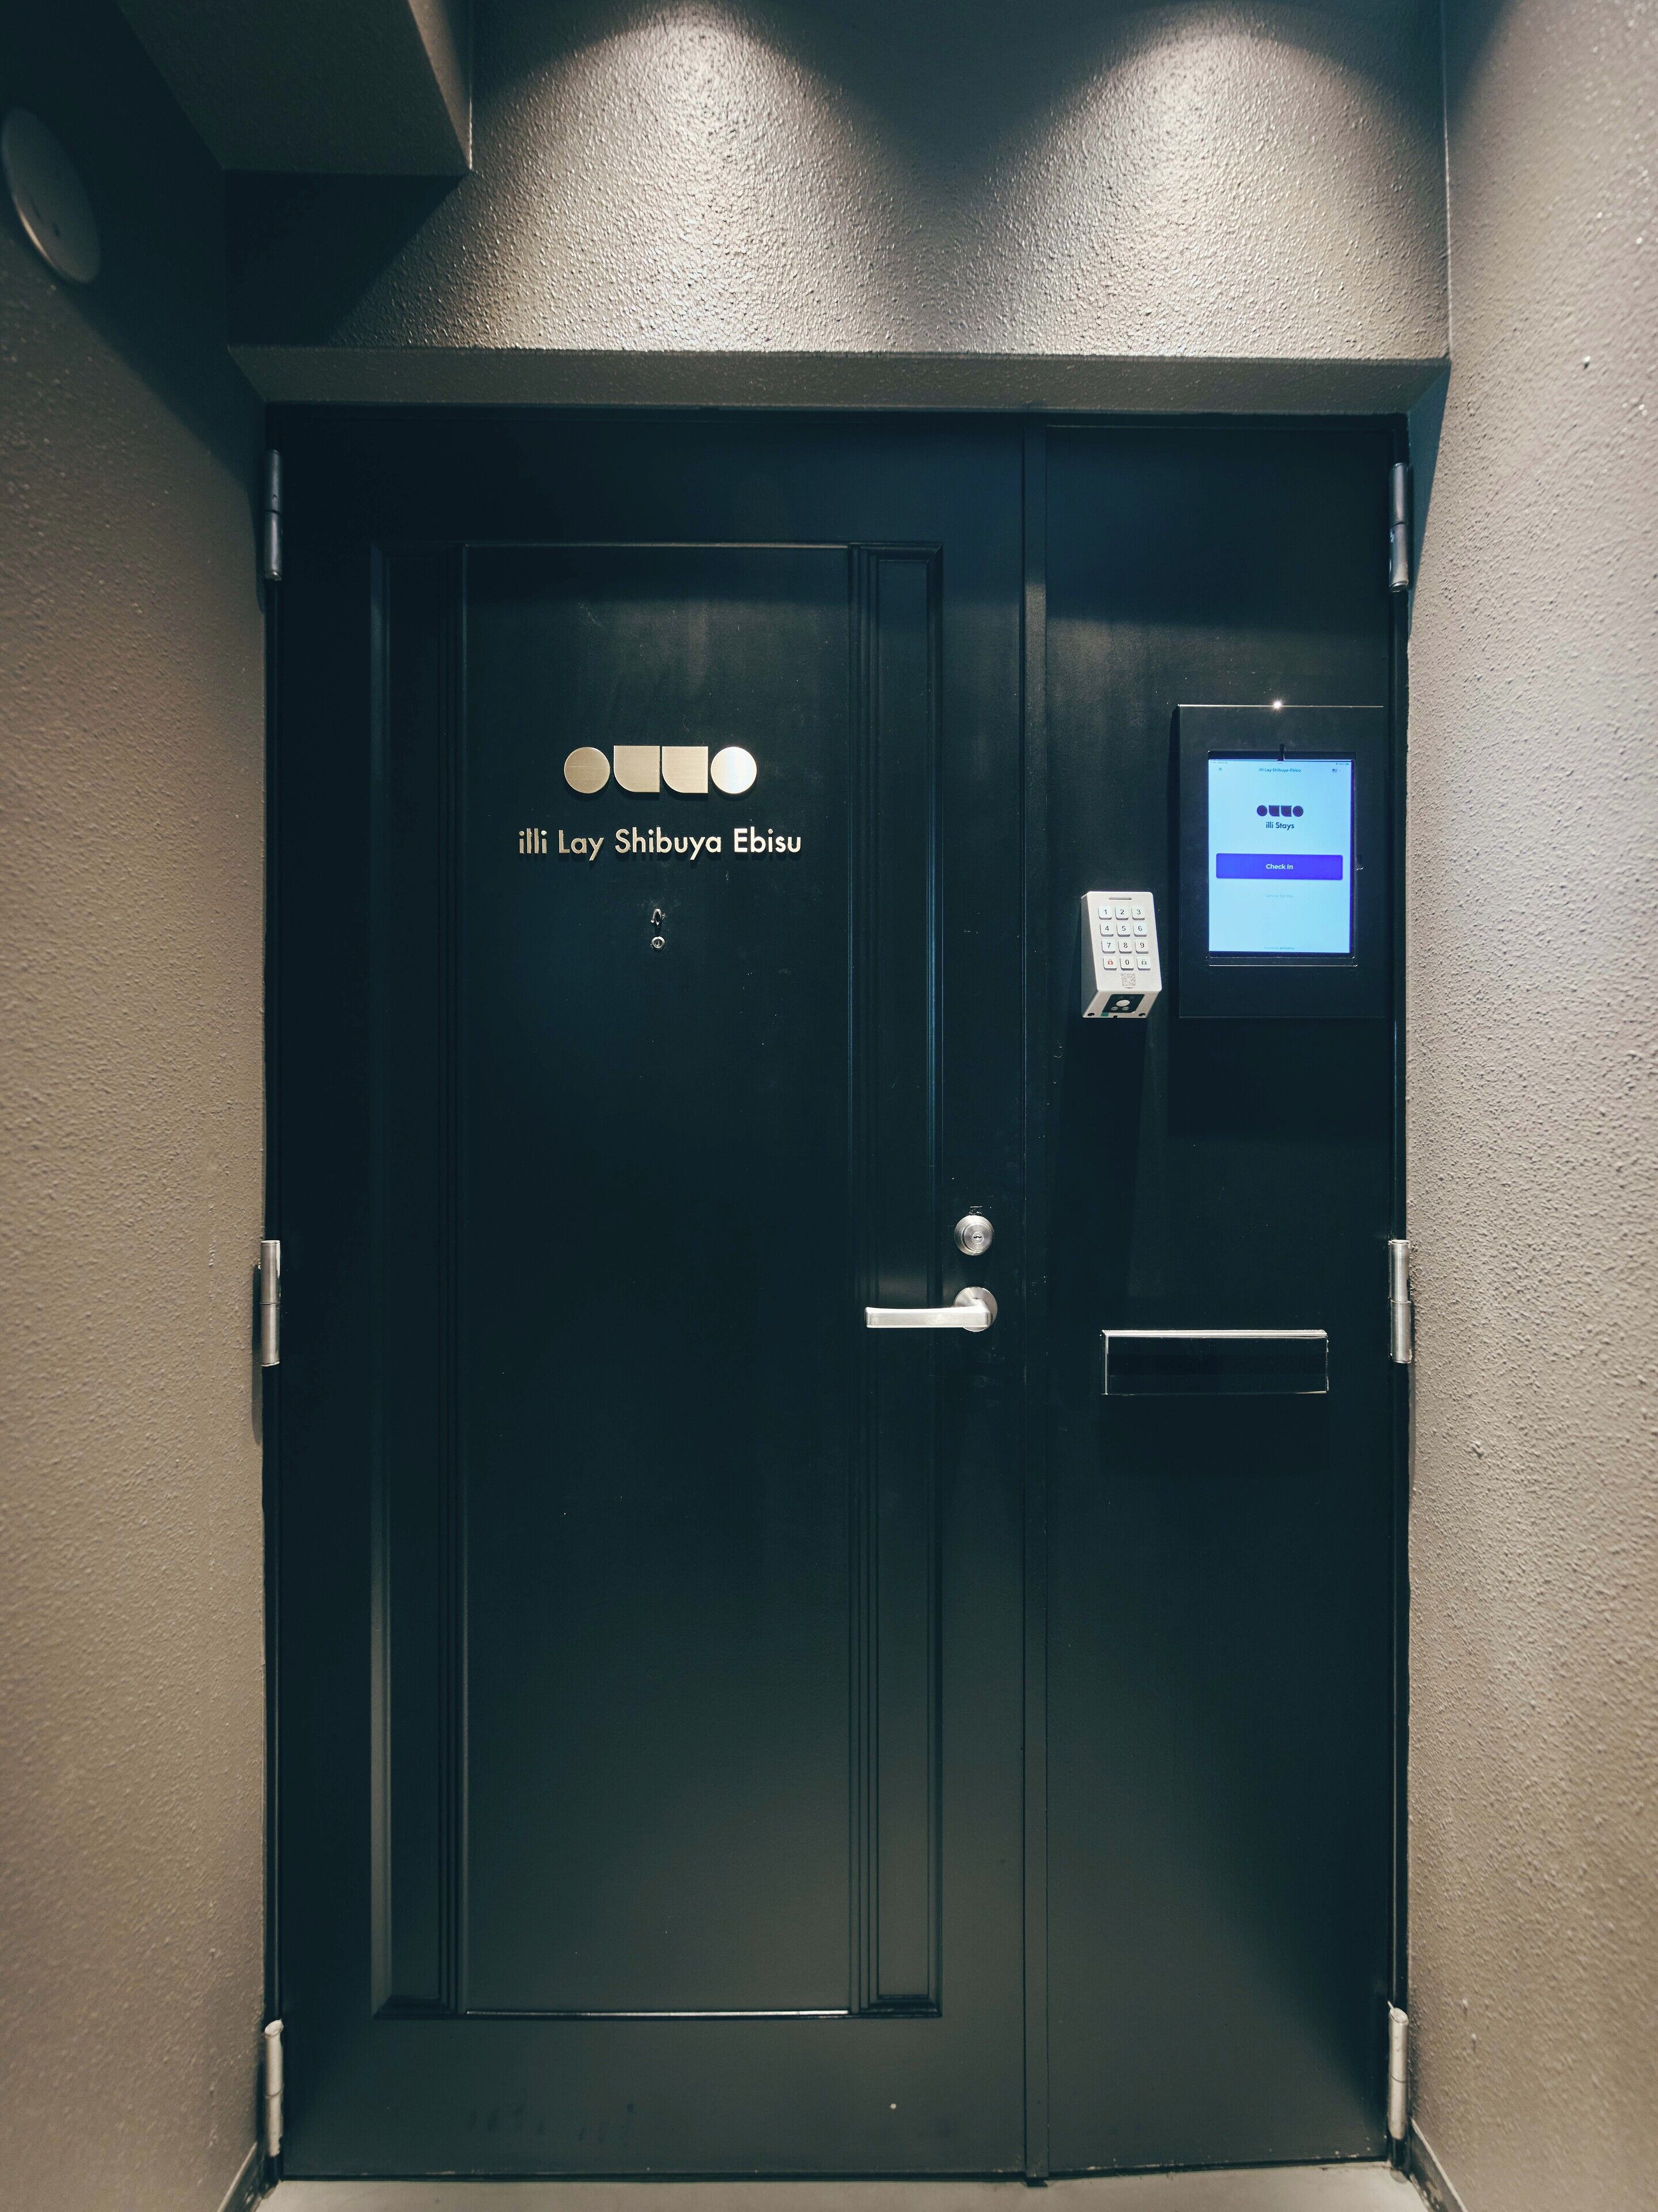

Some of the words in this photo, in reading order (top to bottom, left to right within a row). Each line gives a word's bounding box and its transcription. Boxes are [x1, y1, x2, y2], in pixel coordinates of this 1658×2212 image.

[1276, 822, 1295, 831] Stays
[518, 828, 547, 854] illi
[558, 830, 605, 861] Lay
[615, 826, 722, 861] Shibuya
[734, 826, 802, 853] Ebisu
